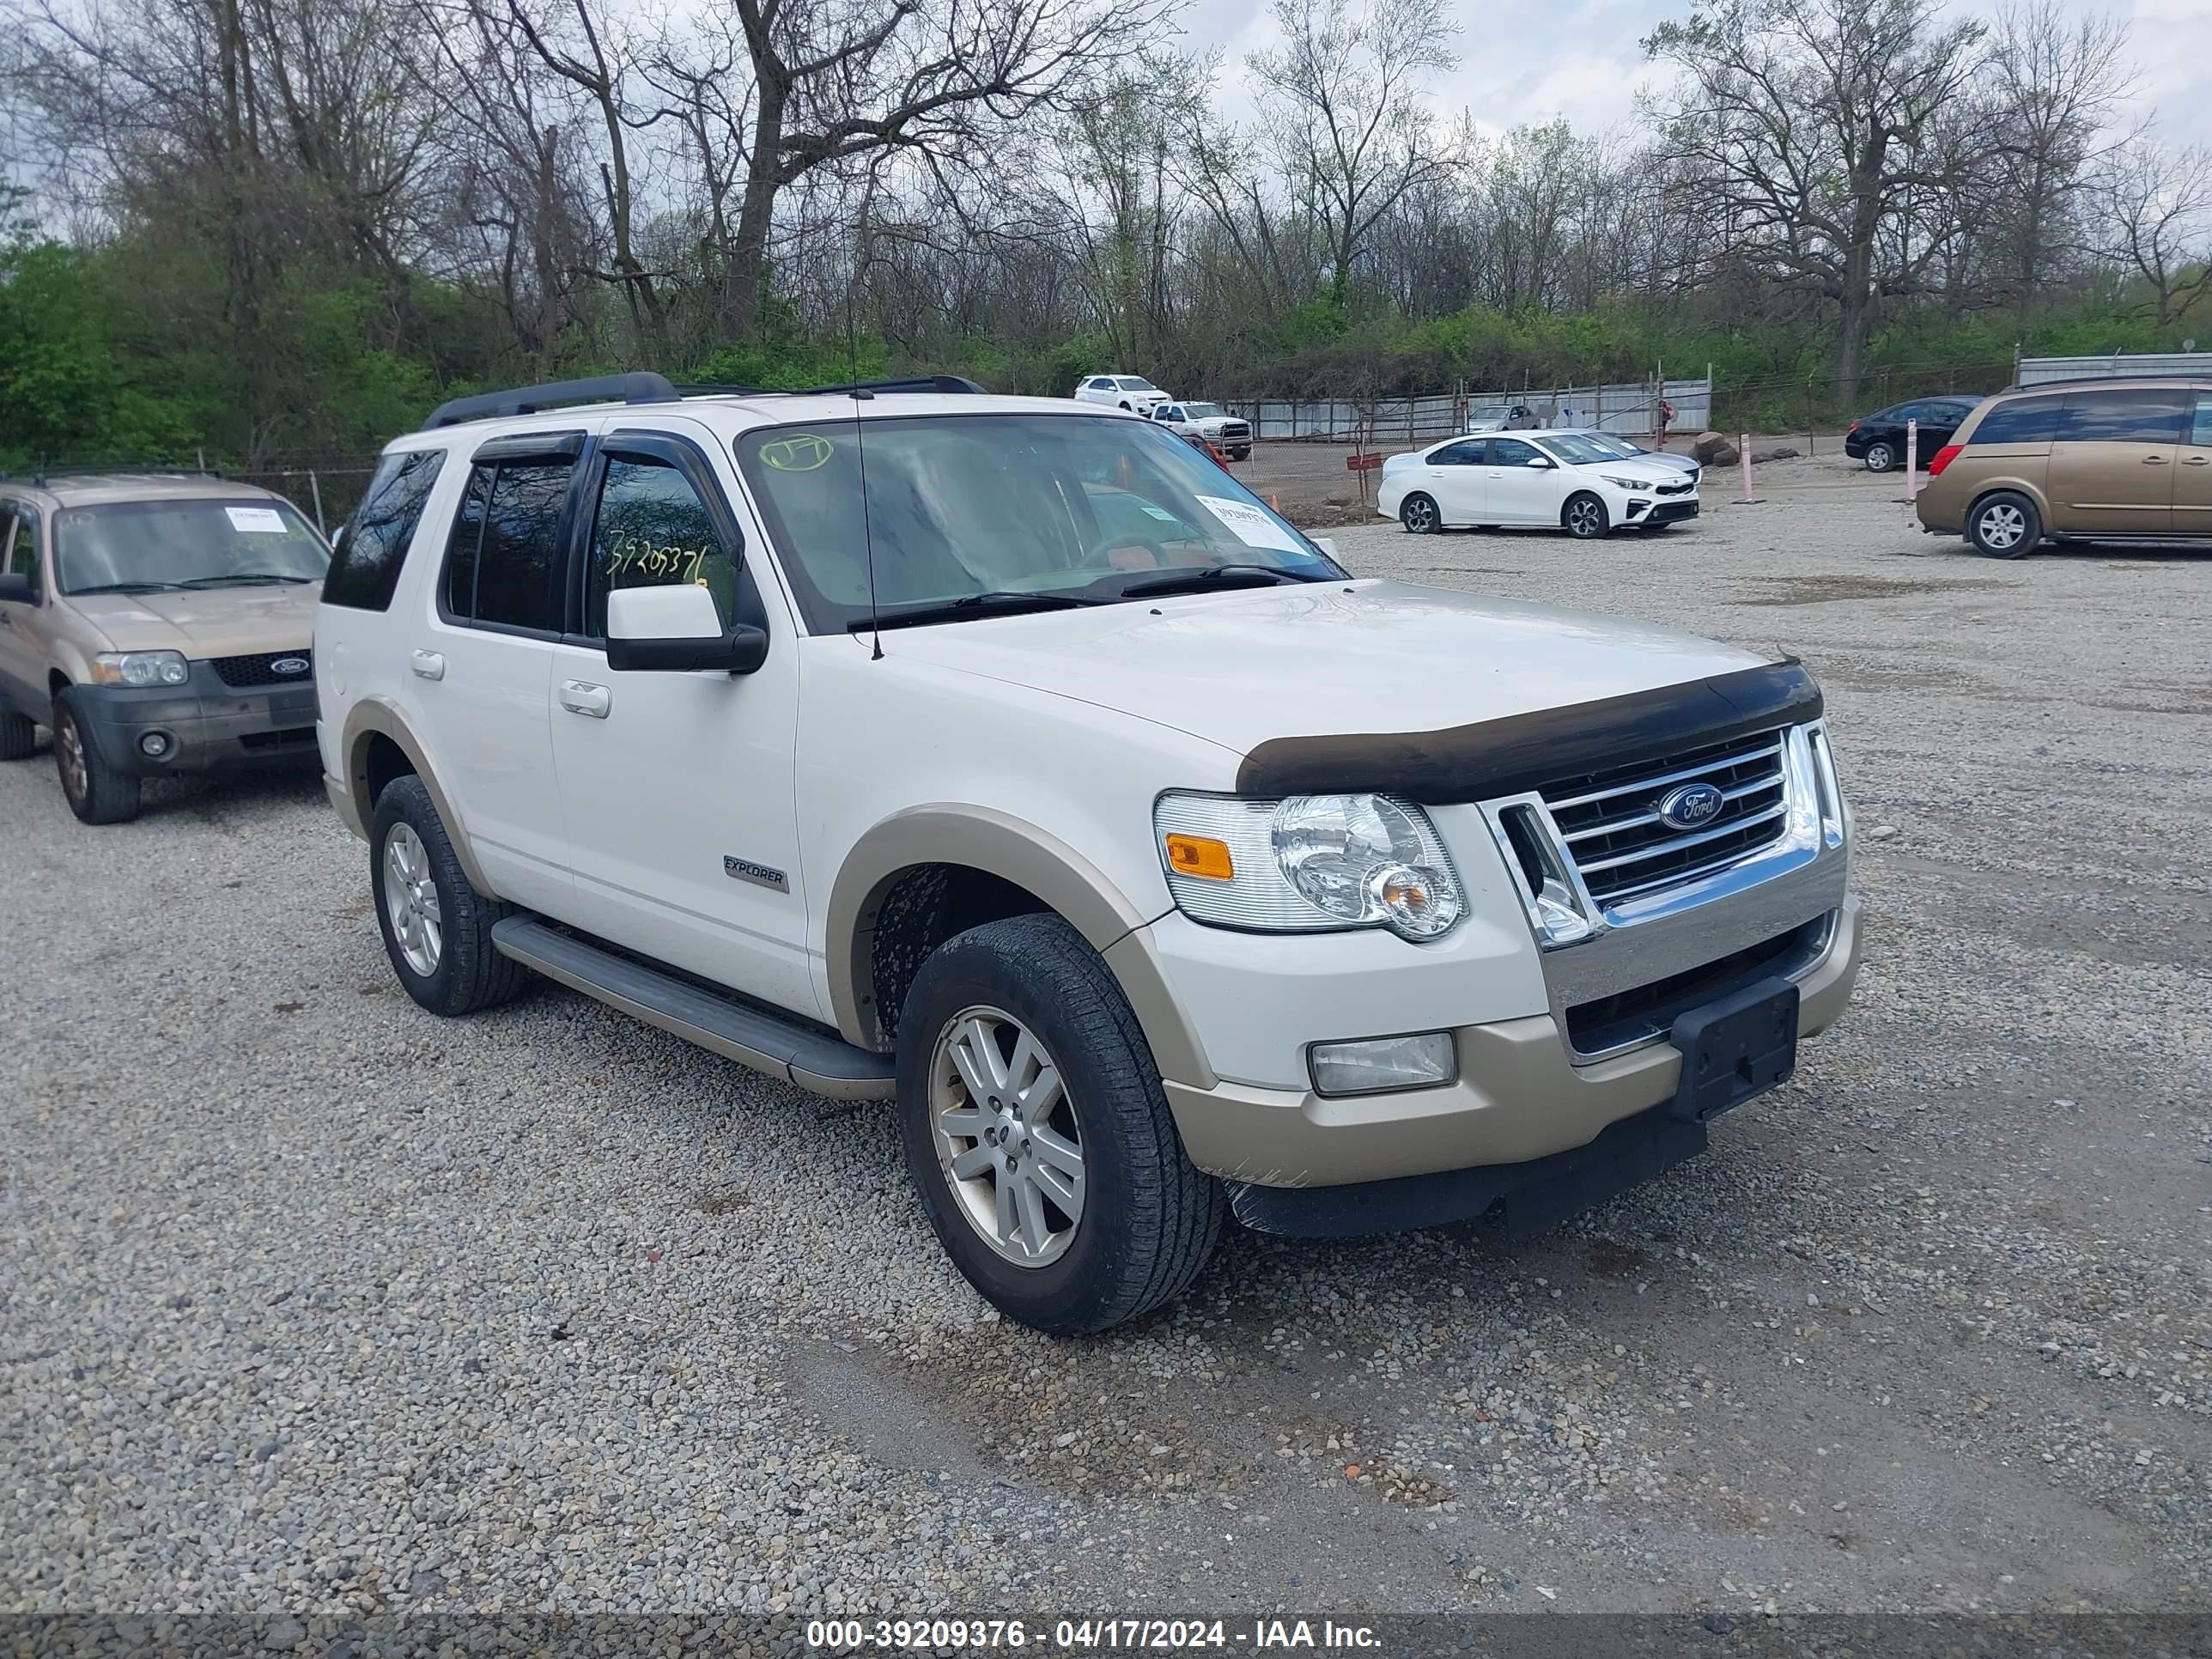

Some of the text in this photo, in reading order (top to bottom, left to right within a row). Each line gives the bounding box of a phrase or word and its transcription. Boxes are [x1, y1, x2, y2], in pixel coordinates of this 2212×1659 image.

[280, 661, 301, 672] Ford
[1683, 792, 1716, 820] Ford
[724, 858, 784, 884] EXPLORER
